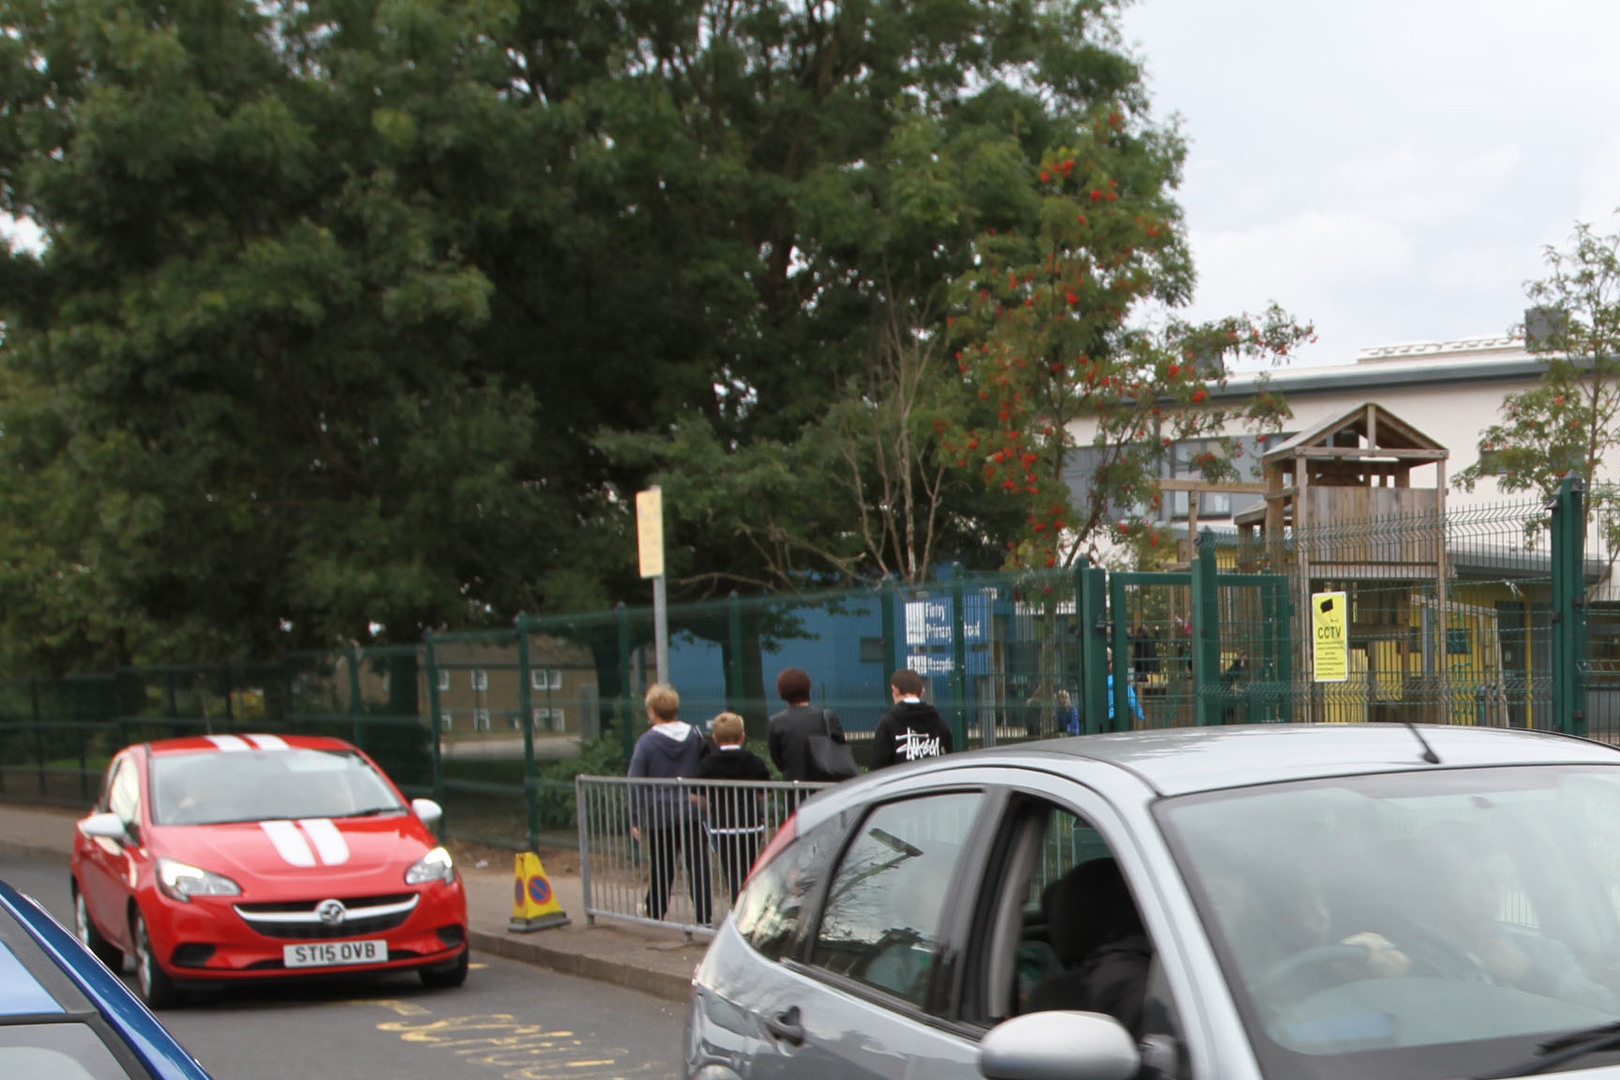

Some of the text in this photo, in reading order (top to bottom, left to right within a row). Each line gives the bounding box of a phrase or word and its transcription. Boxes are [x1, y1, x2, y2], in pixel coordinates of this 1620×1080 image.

[1317, 626, 1341, 639] CCTV
[295, 942, 376, 962] ST15 OVB
